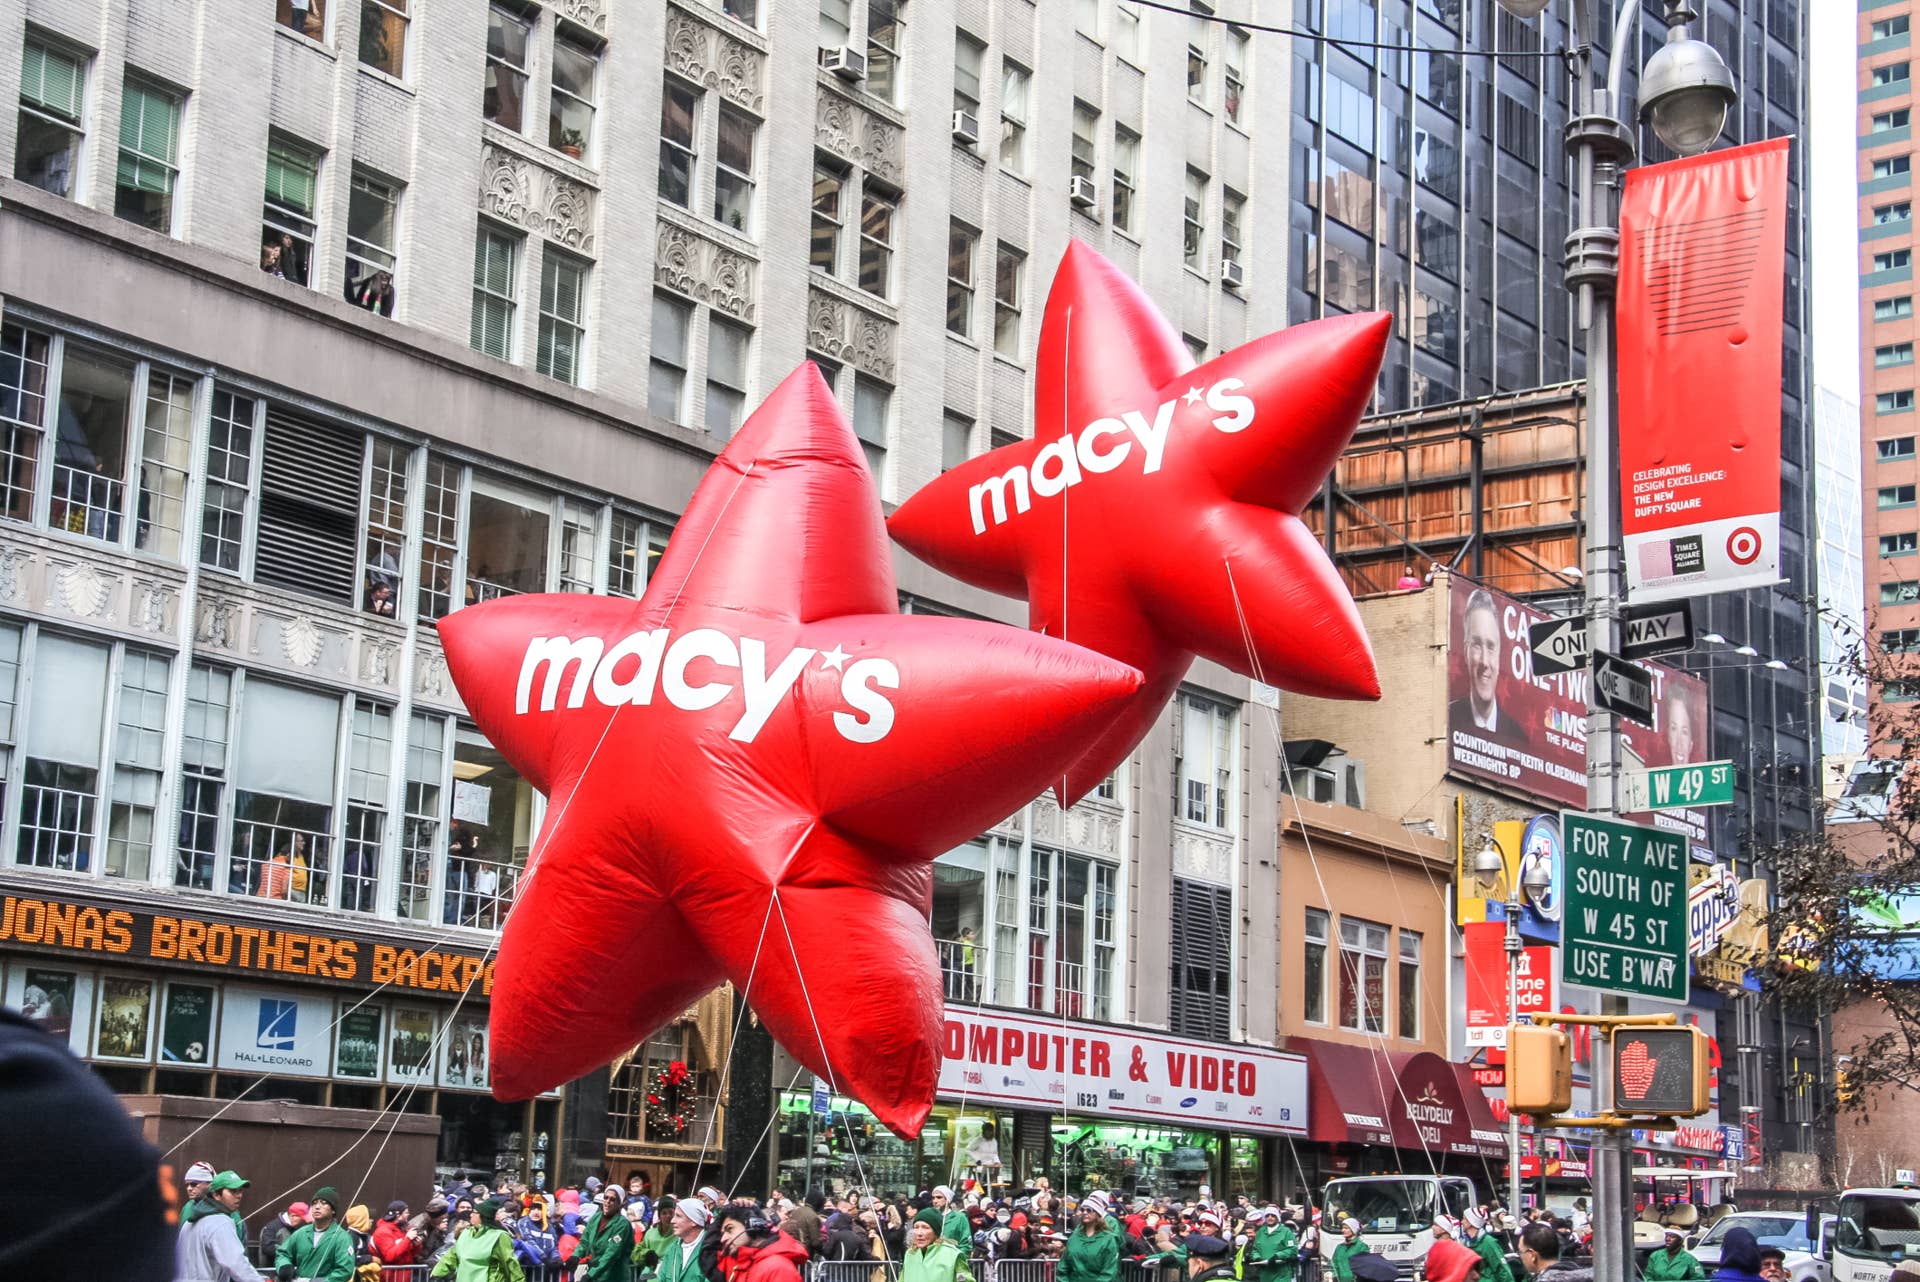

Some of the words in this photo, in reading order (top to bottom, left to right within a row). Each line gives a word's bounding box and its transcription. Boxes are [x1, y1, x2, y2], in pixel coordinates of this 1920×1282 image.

[1633, 463, 1691, 482] CELEBRATING
[1633, 480, 1665, 494] DESIGN
[1634, 494, 1651, 505] THE
[1654, 490, 1674, 502] NEW
[1634, 504, 1663, 518] DUFFY
[1665, 498, 1702, 513] SQUARE
[1674, 551, 1700, 561] SQUARE
[1675, 542, 1698, 552] TIMES
[1627, 616, 1671, 643] WAY
[1602, 671, 1619, 696] ONE
[1629, 681, 1647, 706] WAY
[1453, 730, 1506, 760] COUNTDOWN
[1506, 747, 1521, 761] WITH
[1520, 753, 1544, 773] KEITH
[1545, 732, 1561, 746] THE
[1562, 738, 1585, 754] PLACE
[1453, 746, 1507, 776] WEEKNIGHTS
[1654, 773, 1670, 804] W
[1679, 770, 1704, 801] 49
[1712, 767, 1728, 784] ST
[1573, 827, 1609, 858] FOR
[1620, 835, 1632, 861] 7
[1644, 841, 1678, 870] AVE
[1576, 867, 1639, 902] SOUTH
[1651, 880, 1675, 907] OF
[0, 896, 134, 953] JONAS
[150, 915, 358, 979] BROTHERS
[1584, 907, 1598, 935] W
[1609, 912, 1635, 941] 45
[1646, 918, 1668, 946] ST
[1573, 948, 1610, 979] USE
[1622, 956, 1676, 989] B'WAY
[1128, 1044, 1149, 1083] &
[1166, 1051, 1256, 1097] VIDEO
[1077, 1092, 1098, 1108] 1623
[1248, 1106, 1263, 1116] JVC
[1406, 1103, 1453, 1124] BELLYDELLY
[1422, 1126, 1440, 1143] DELI
[1853, 1271, 1876, 1281] NORTH
